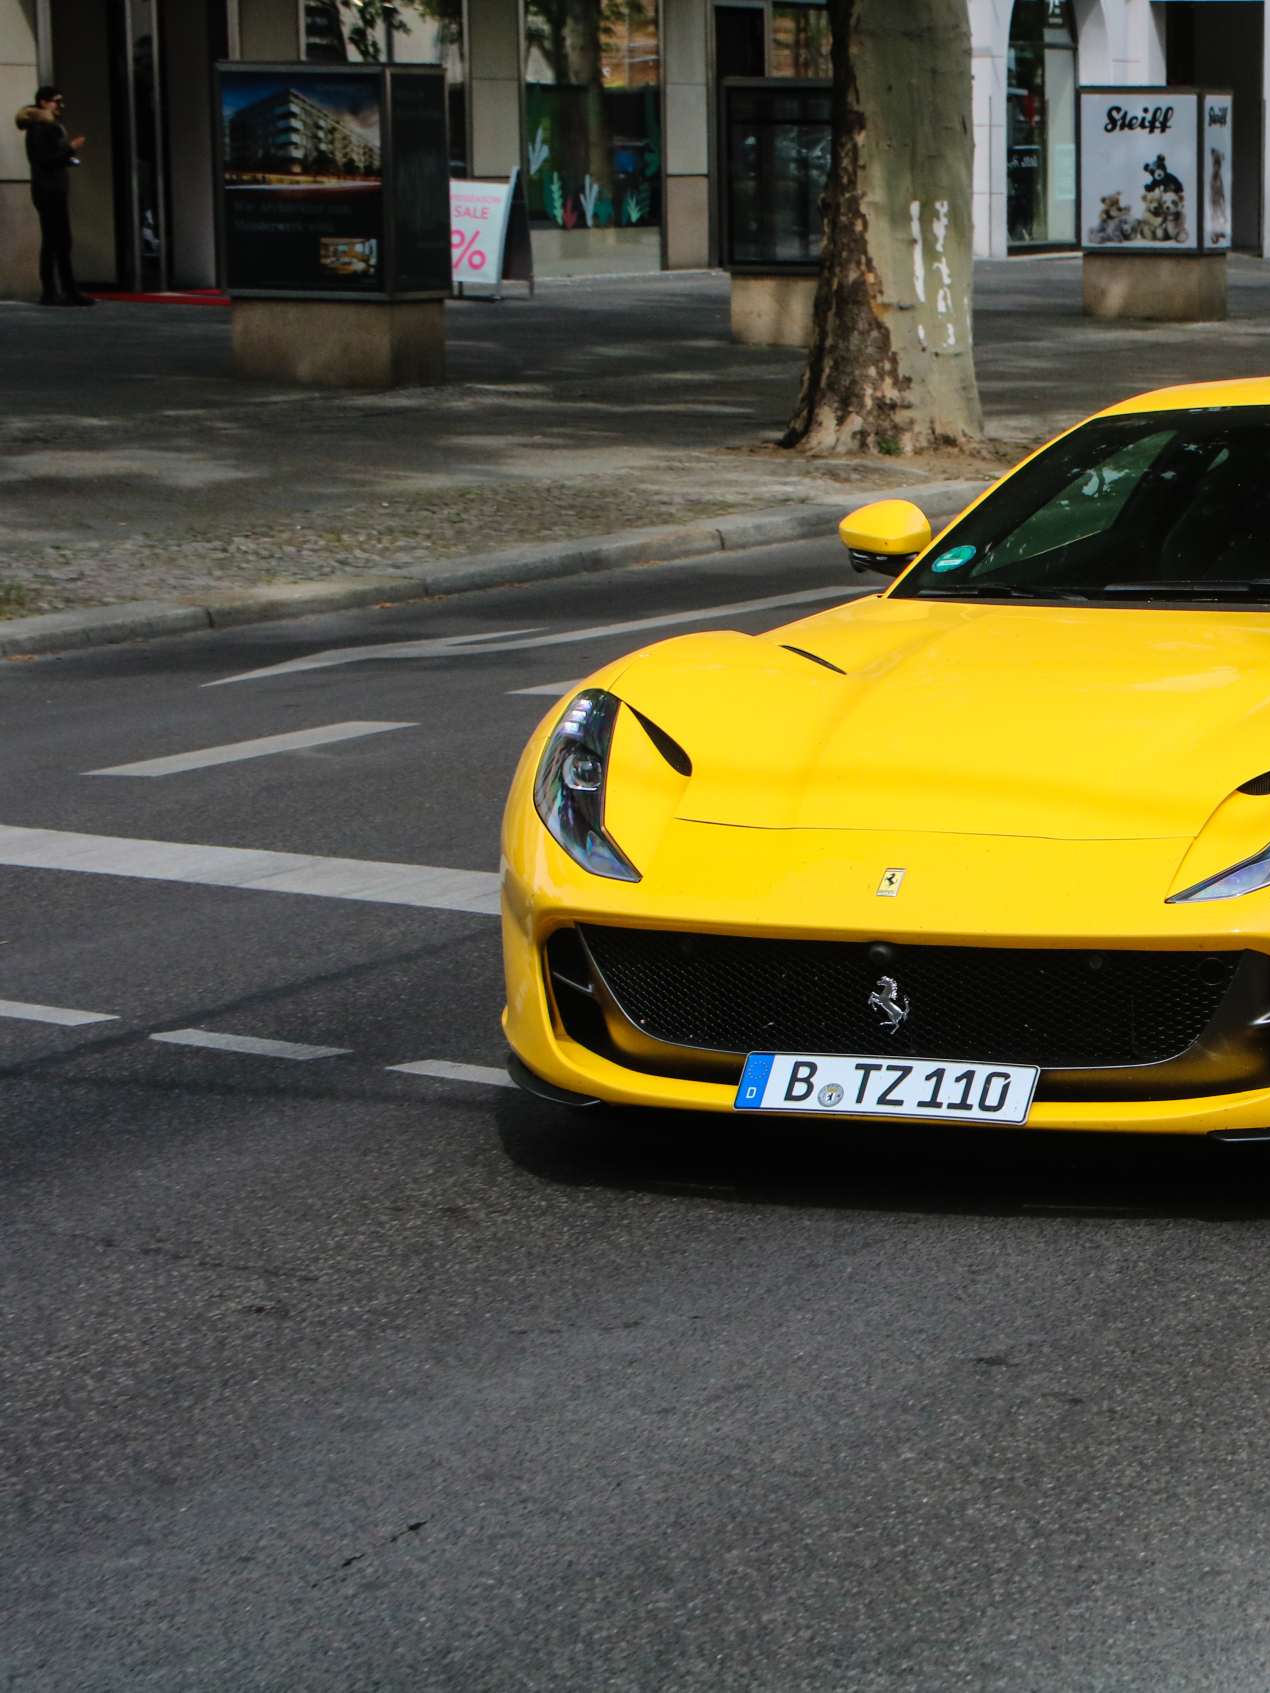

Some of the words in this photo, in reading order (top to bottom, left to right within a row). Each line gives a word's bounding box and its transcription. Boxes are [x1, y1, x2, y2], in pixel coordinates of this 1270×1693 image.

[1104, 105, 1174, 135] Steiff
[454, 205, 490, 220] SALE
[745, 1086, 756, 1100] D
[783, 1060, 819, 1103] B
